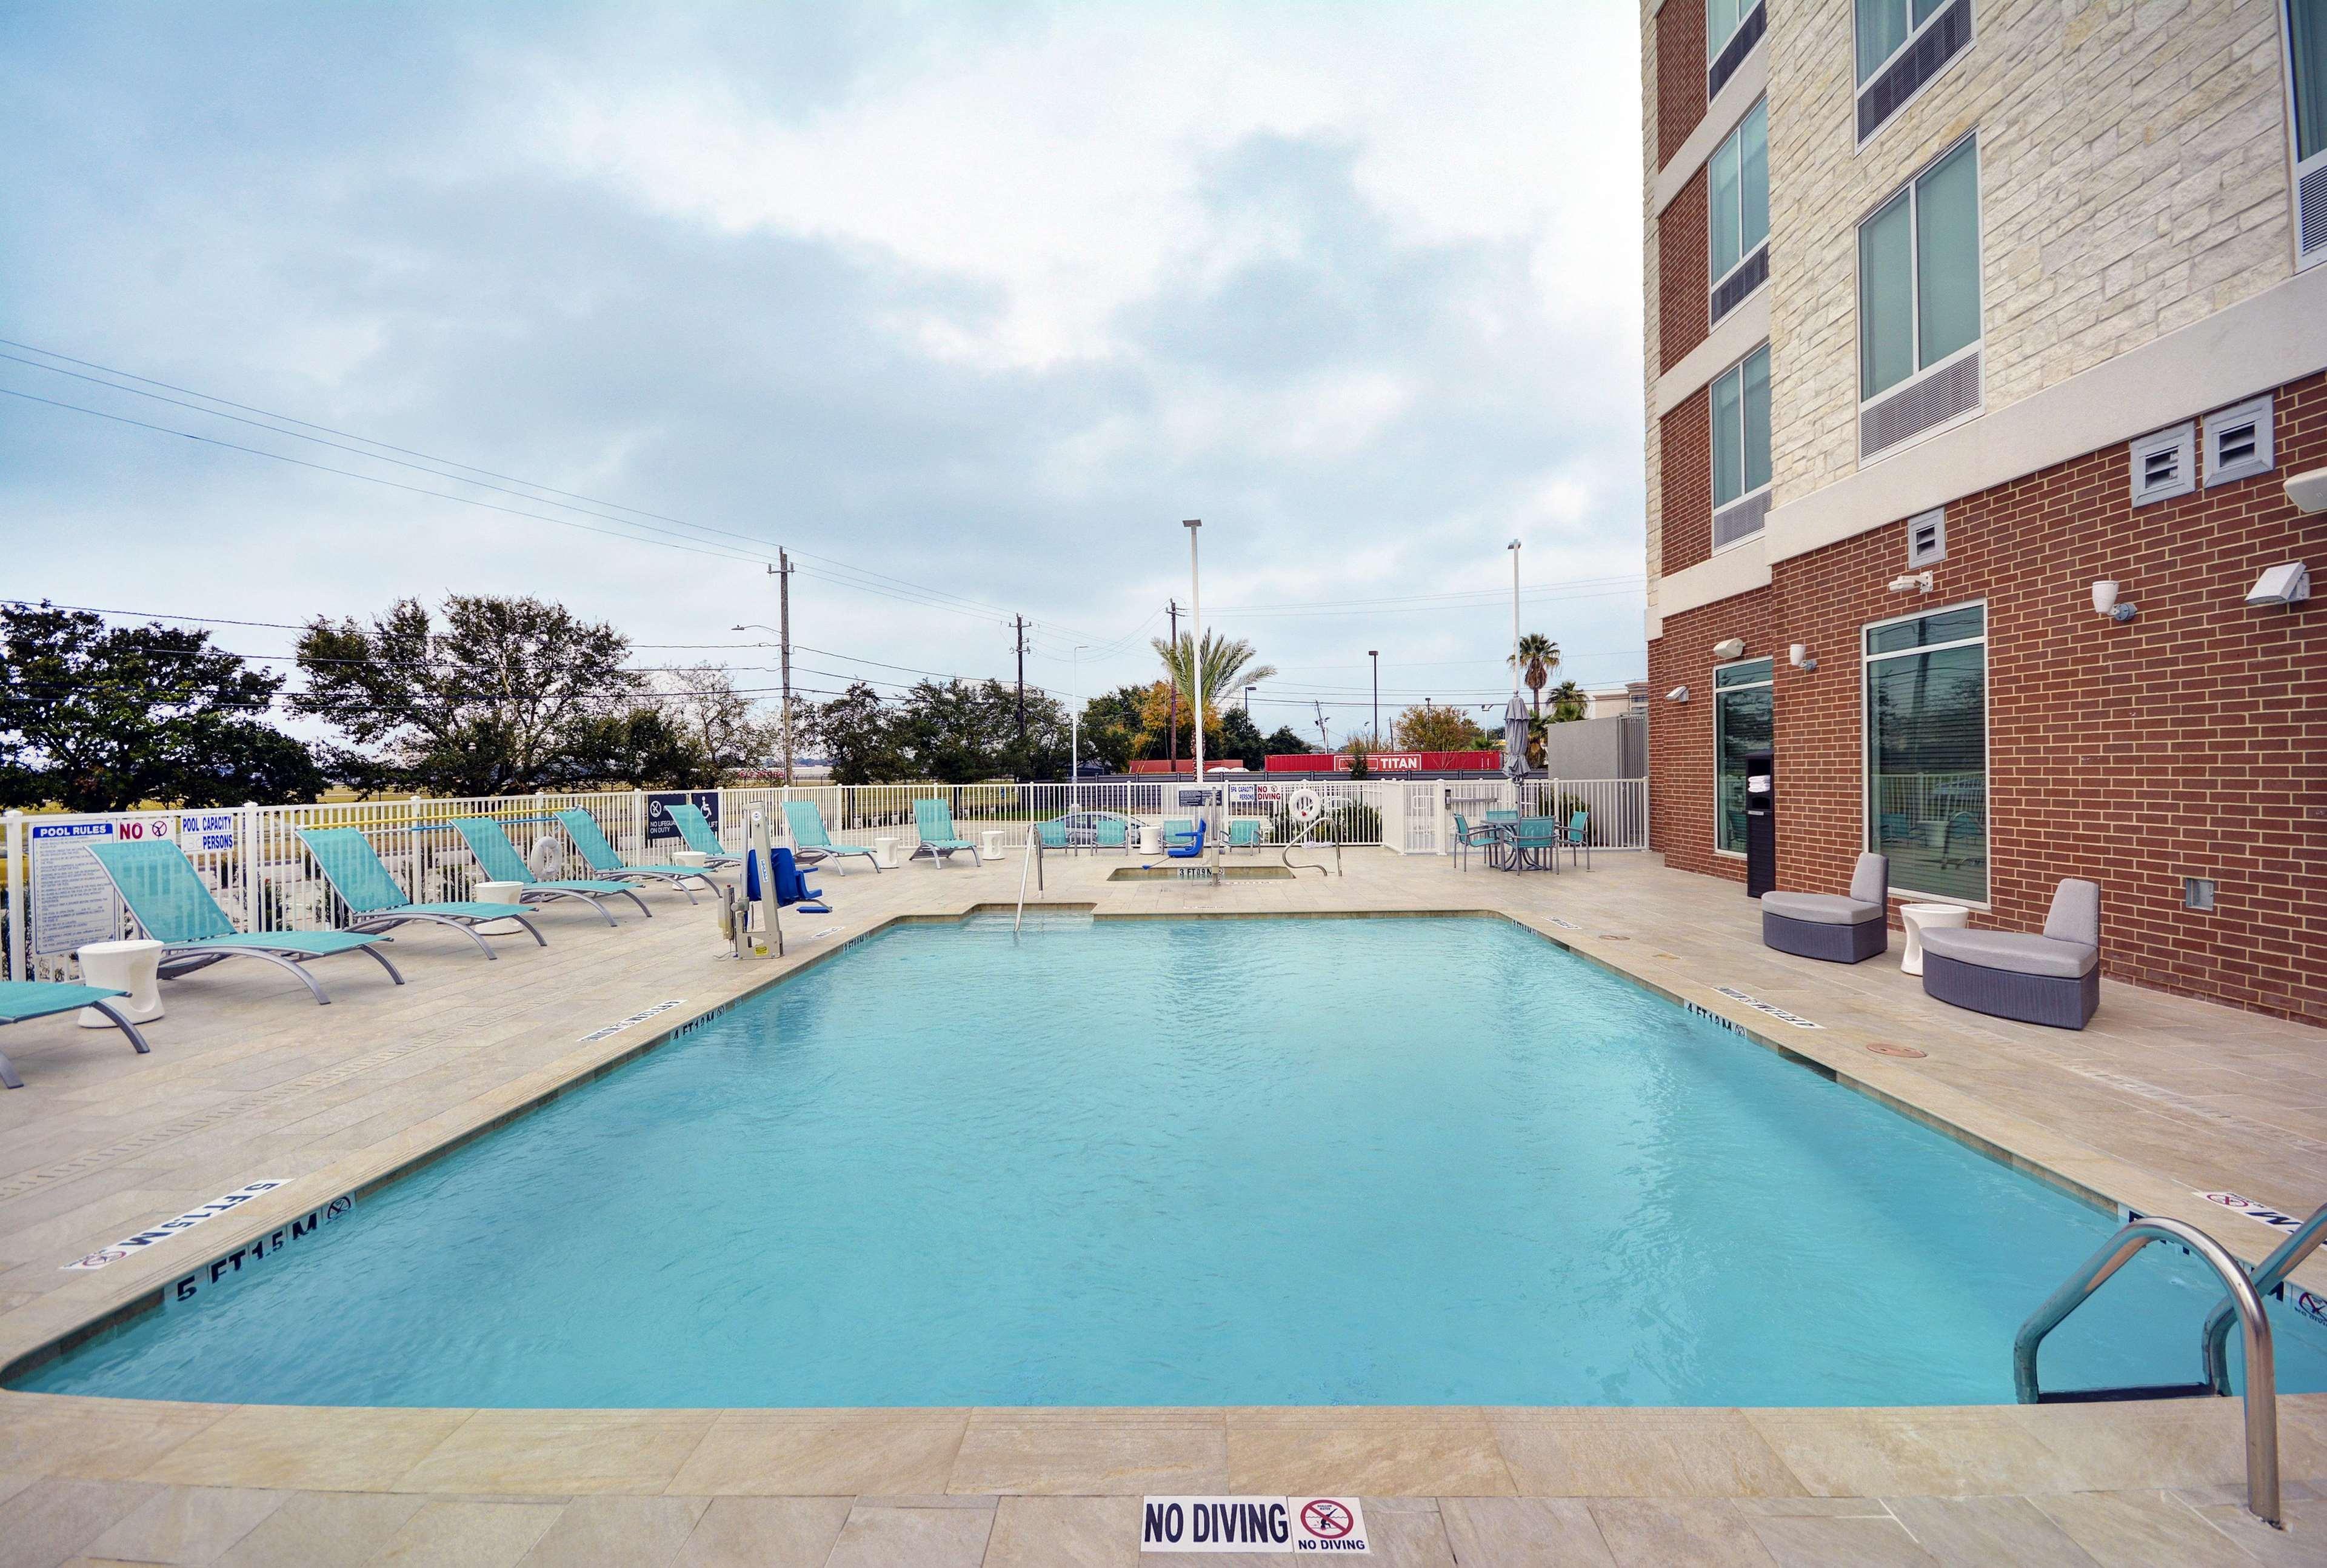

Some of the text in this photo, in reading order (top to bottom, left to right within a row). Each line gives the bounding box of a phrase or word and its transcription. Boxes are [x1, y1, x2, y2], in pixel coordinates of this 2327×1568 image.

[1380, 758, 1417, 769] TITAN
[41, 824, 106, 837] POOL RULES
[120, 822, 143, 840] NO
[183, 816, 232, 832] POOL CAPACITY
[203, 834, 233, 850] PERSONS
[1187, 869, 1195, 877] FT
[1697, 1006, 1707, 1018] FT
[683, 1023, 693, 1036] FT
[706, 1012, 714, 1023] M
[118, 1232, 173, 1246] M
[177, 1275, 197, 1302] 5
[211, 1249, 245, 1284] FT
[293, 1212, 317, 1240] M
[1144, 1503, 1289, 1544] NO DIVING
[1298, 1540, 1366, 1550] NO DIVING
